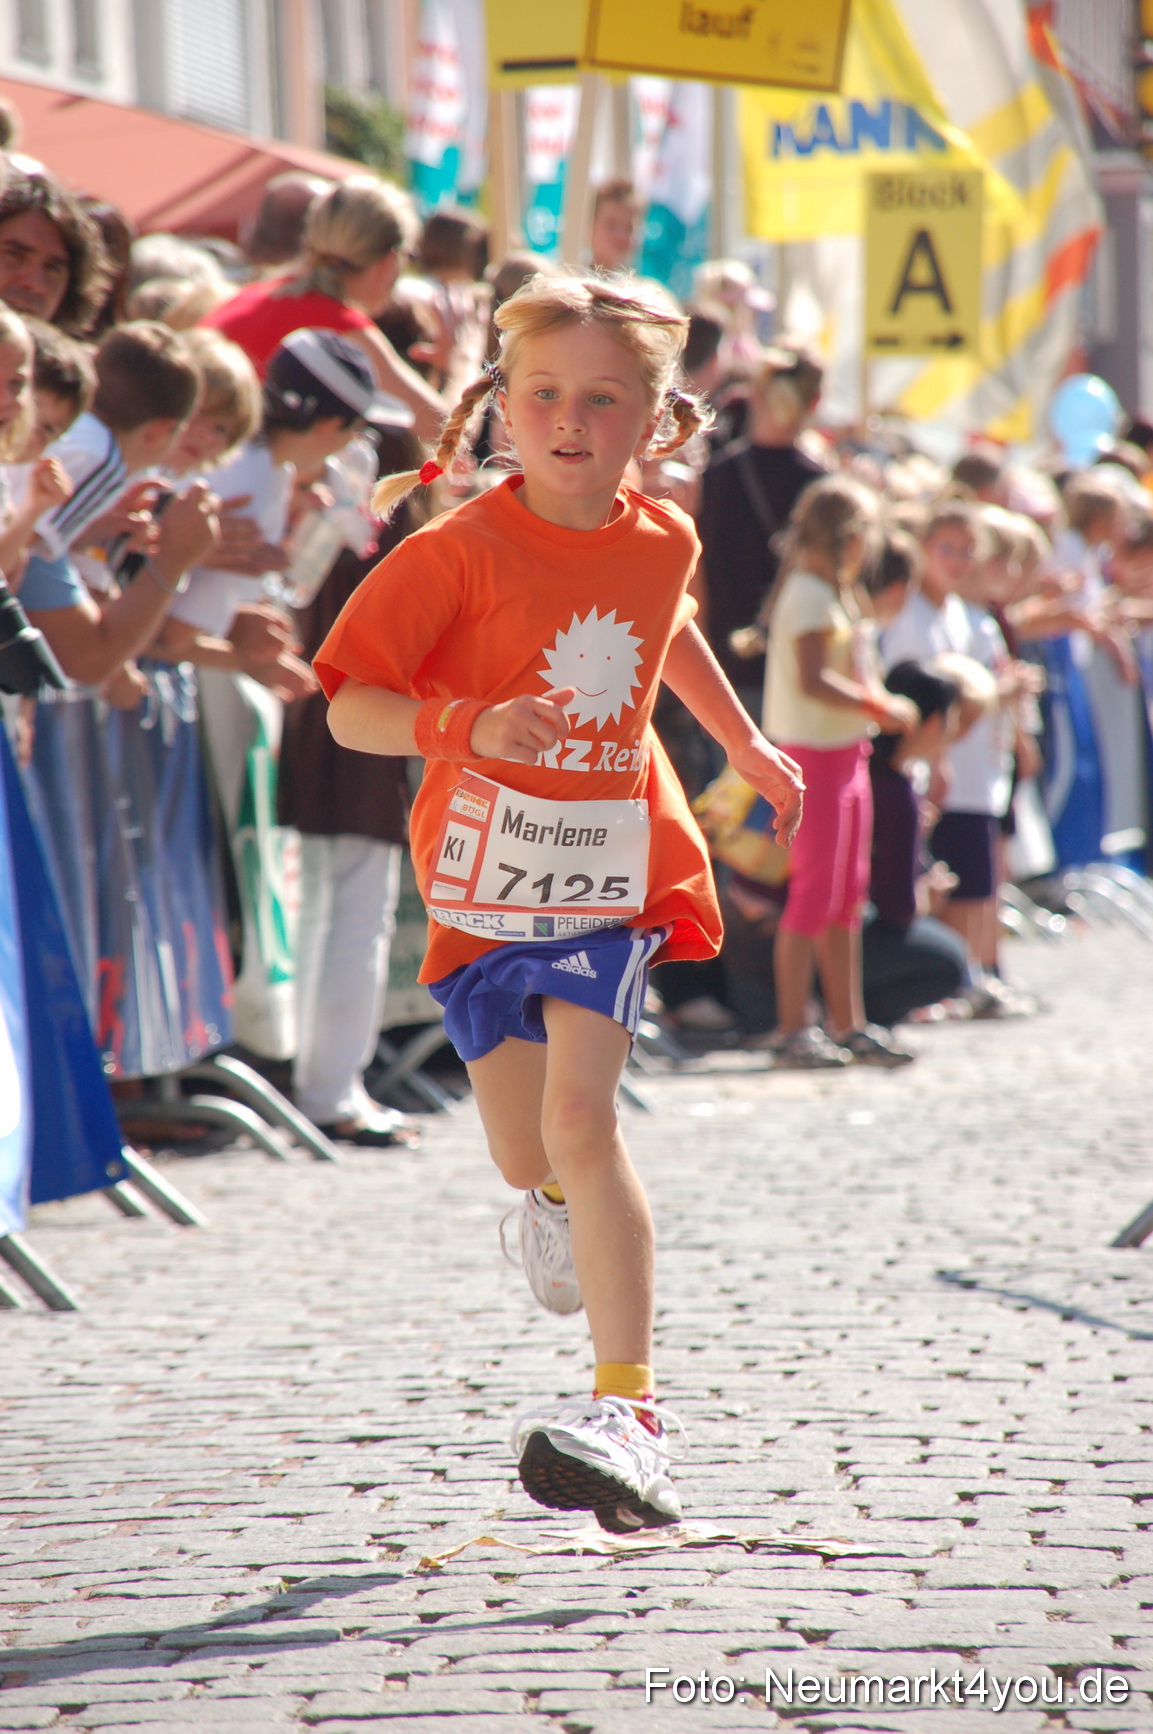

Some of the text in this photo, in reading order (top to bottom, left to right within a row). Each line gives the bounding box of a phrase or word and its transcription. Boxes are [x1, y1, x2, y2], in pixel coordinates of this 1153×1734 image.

[680, 1, 757, 37] lauf
[878, 174, 968, 209] Block
[890, 228, 953, 316] A
[501, 805, 608, 847] Marlene
[443, 835, 466, 862] K1
[496, 861, 630, 904] 7125
[433, 908, 505, 930] BOCK
[551, 961, 598, 979] adidas
